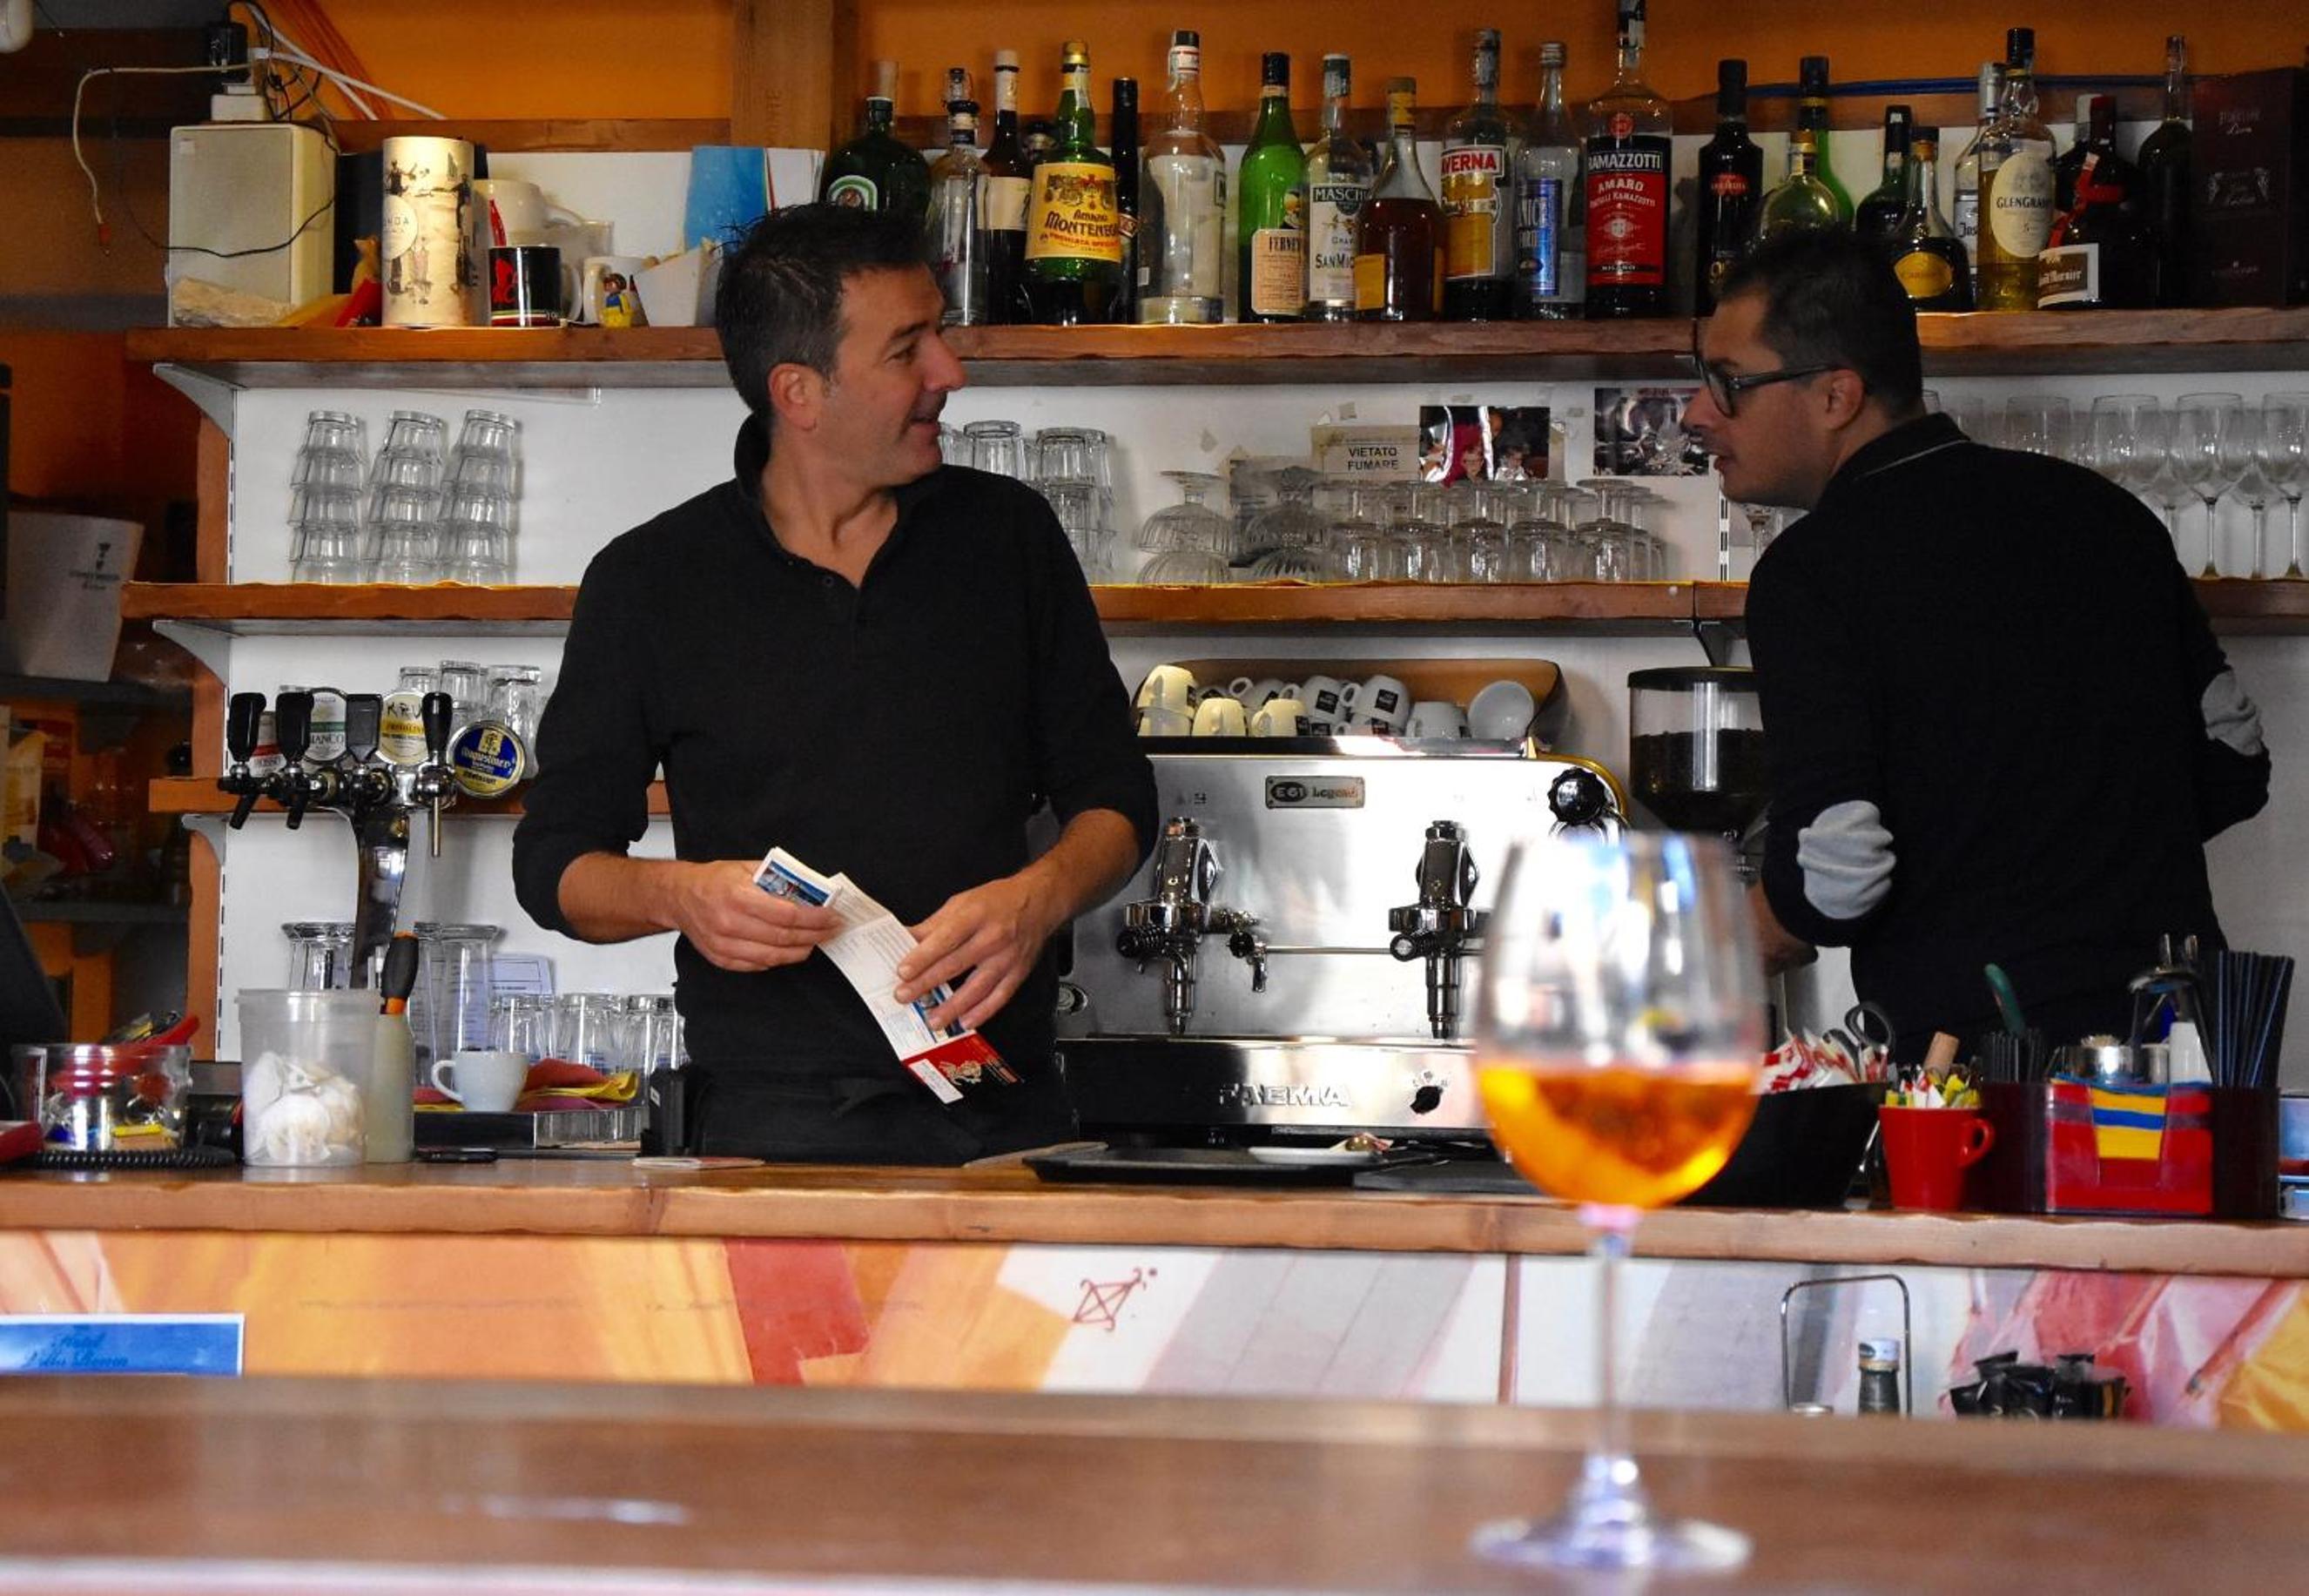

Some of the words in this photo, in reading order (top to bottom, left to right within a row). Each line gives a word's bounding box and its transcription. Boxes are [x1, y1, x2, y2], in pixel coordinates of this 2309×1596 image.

[1598, 178, 1644, 193] AMARO
[1044, 211, 1119, 238] MONTENEG
[1348, 447, 1397, 457] VIETATO
[1348, 459, 1399, 471] FUMARE
[310, 734, 345, 744] IANCO
[1220, 1083, 1350, 1107] FAEMA
